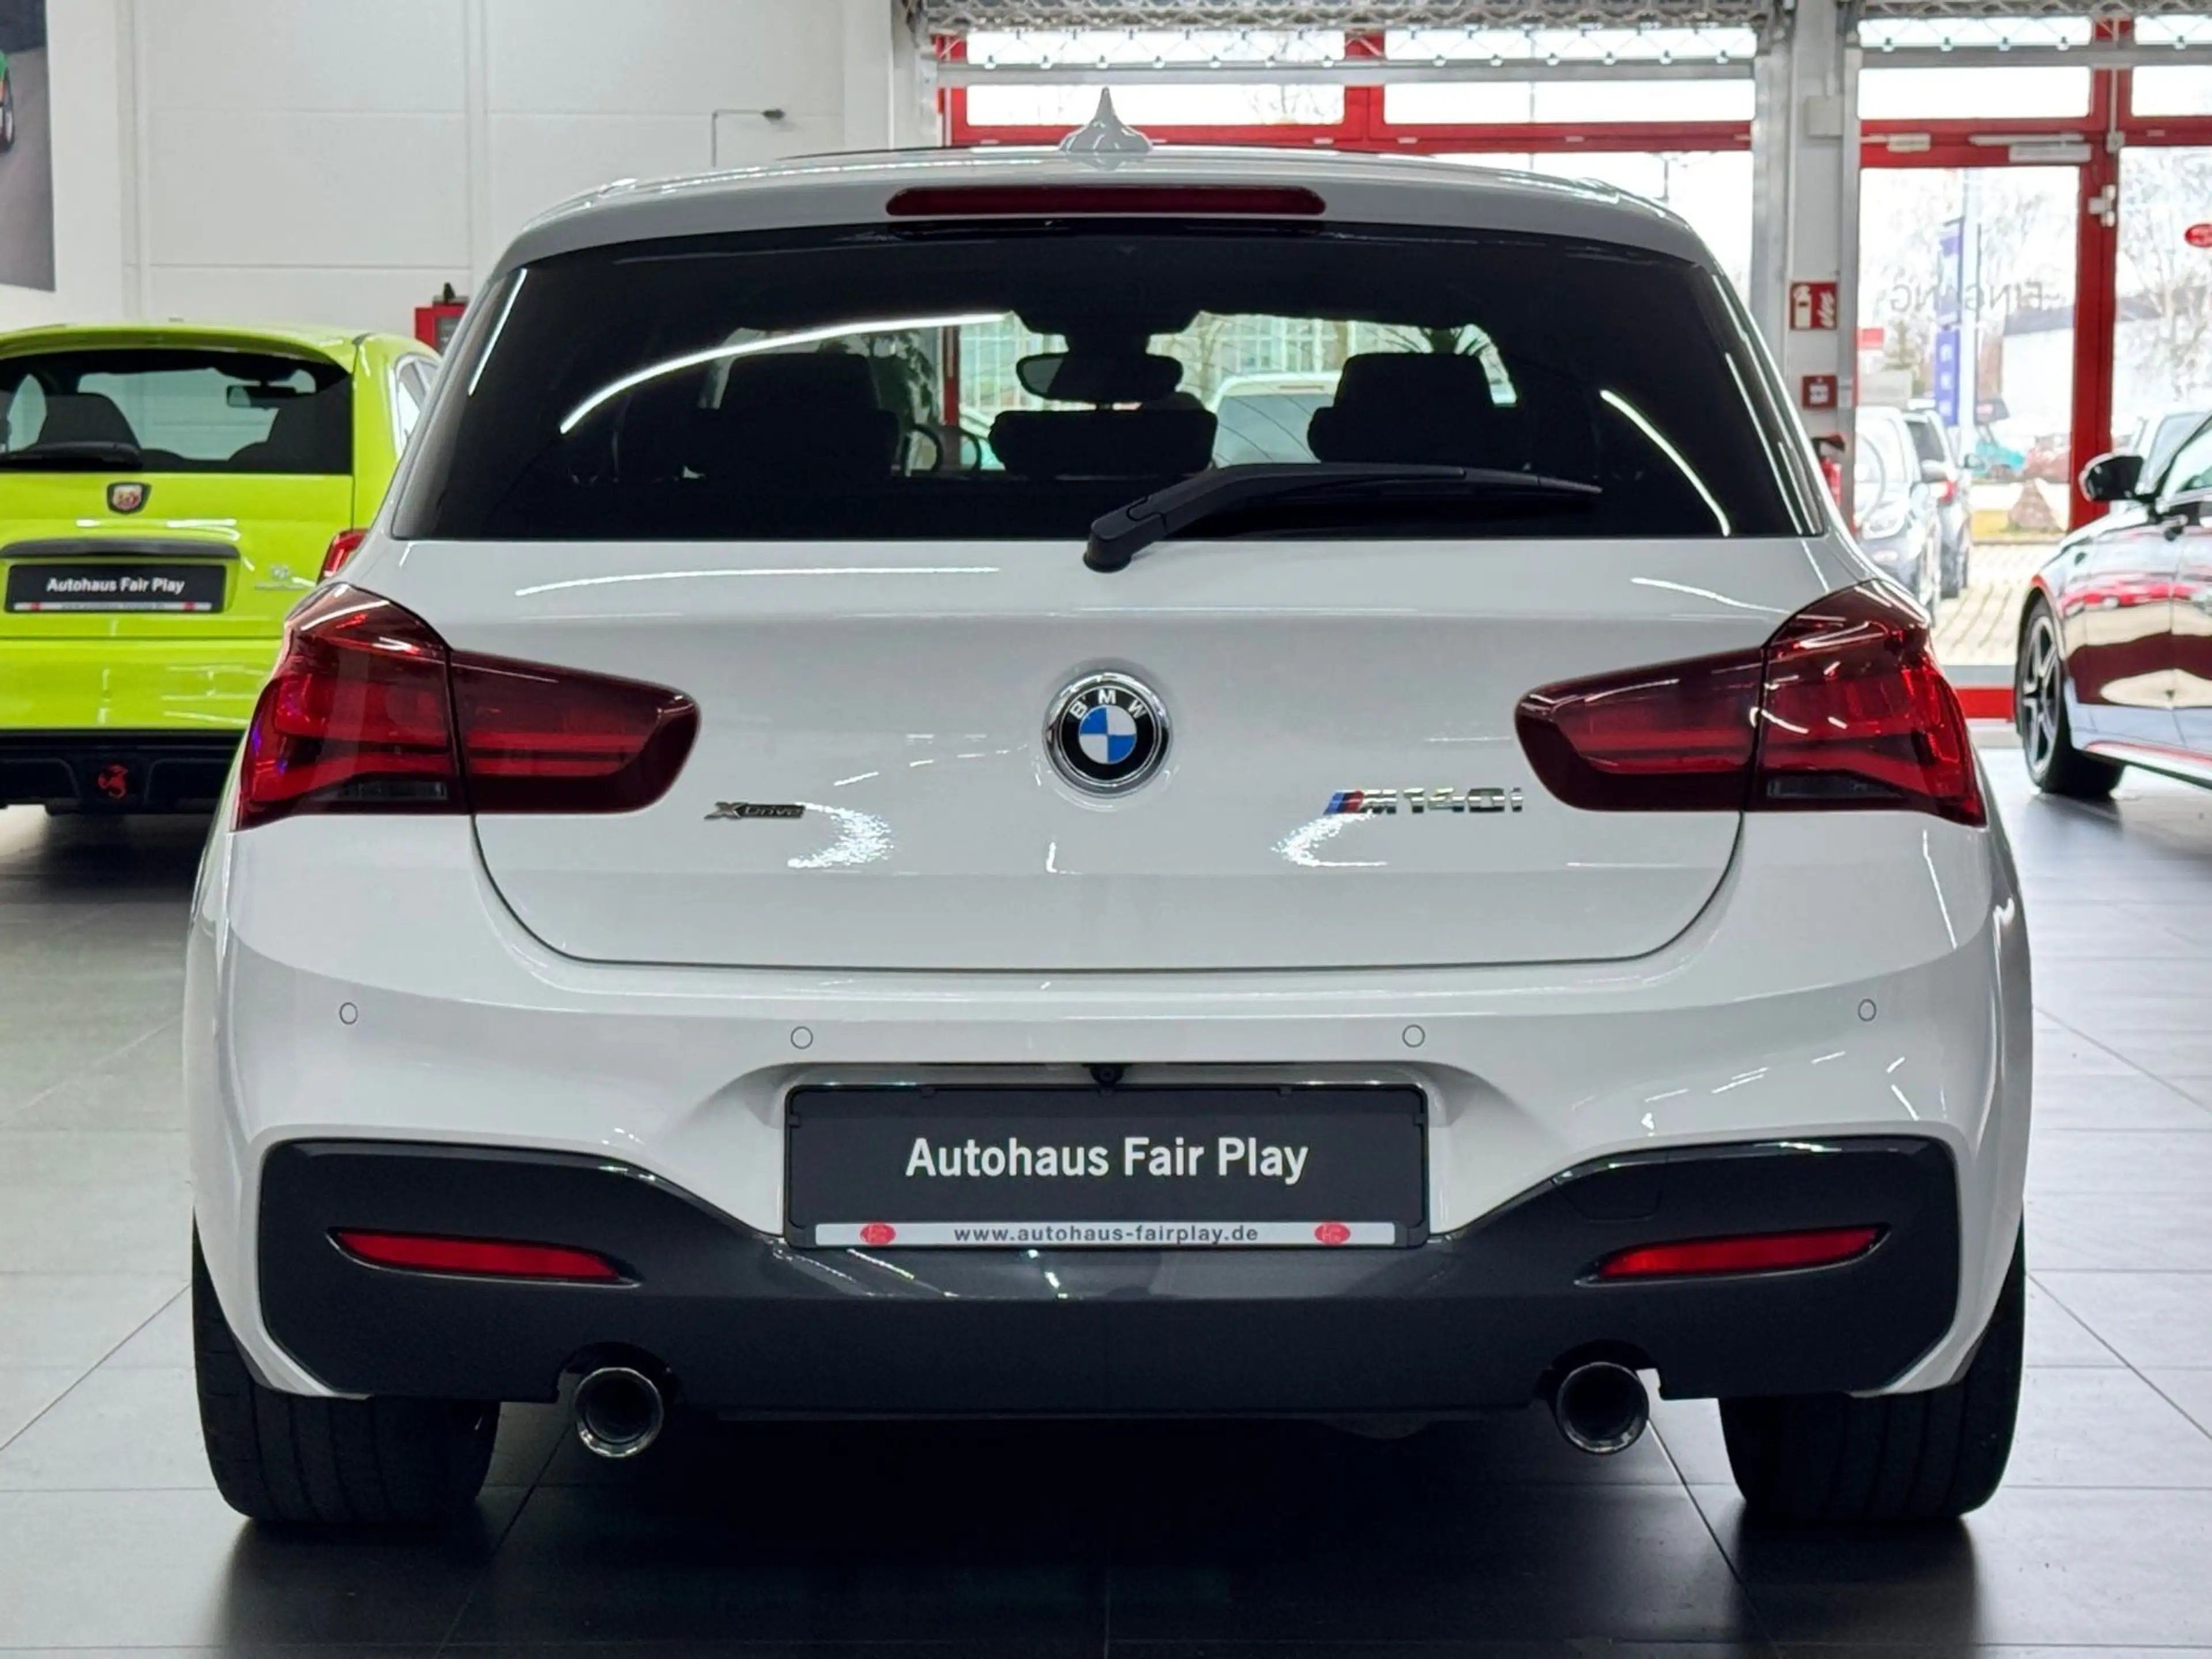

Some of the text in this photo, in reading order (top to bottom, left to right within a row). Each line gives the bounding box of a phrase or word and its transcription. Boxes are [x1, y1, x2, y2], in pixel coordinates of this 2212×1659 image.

[46, 577, 185, 595] Autohaus Fair Play
[1069, 689, 1148, 720] BMW
[905, 1137, 1309, 1185] Autohaus Fair Play
[954, 1224, 1259, 1244] www.autohaus-fairplay.de
